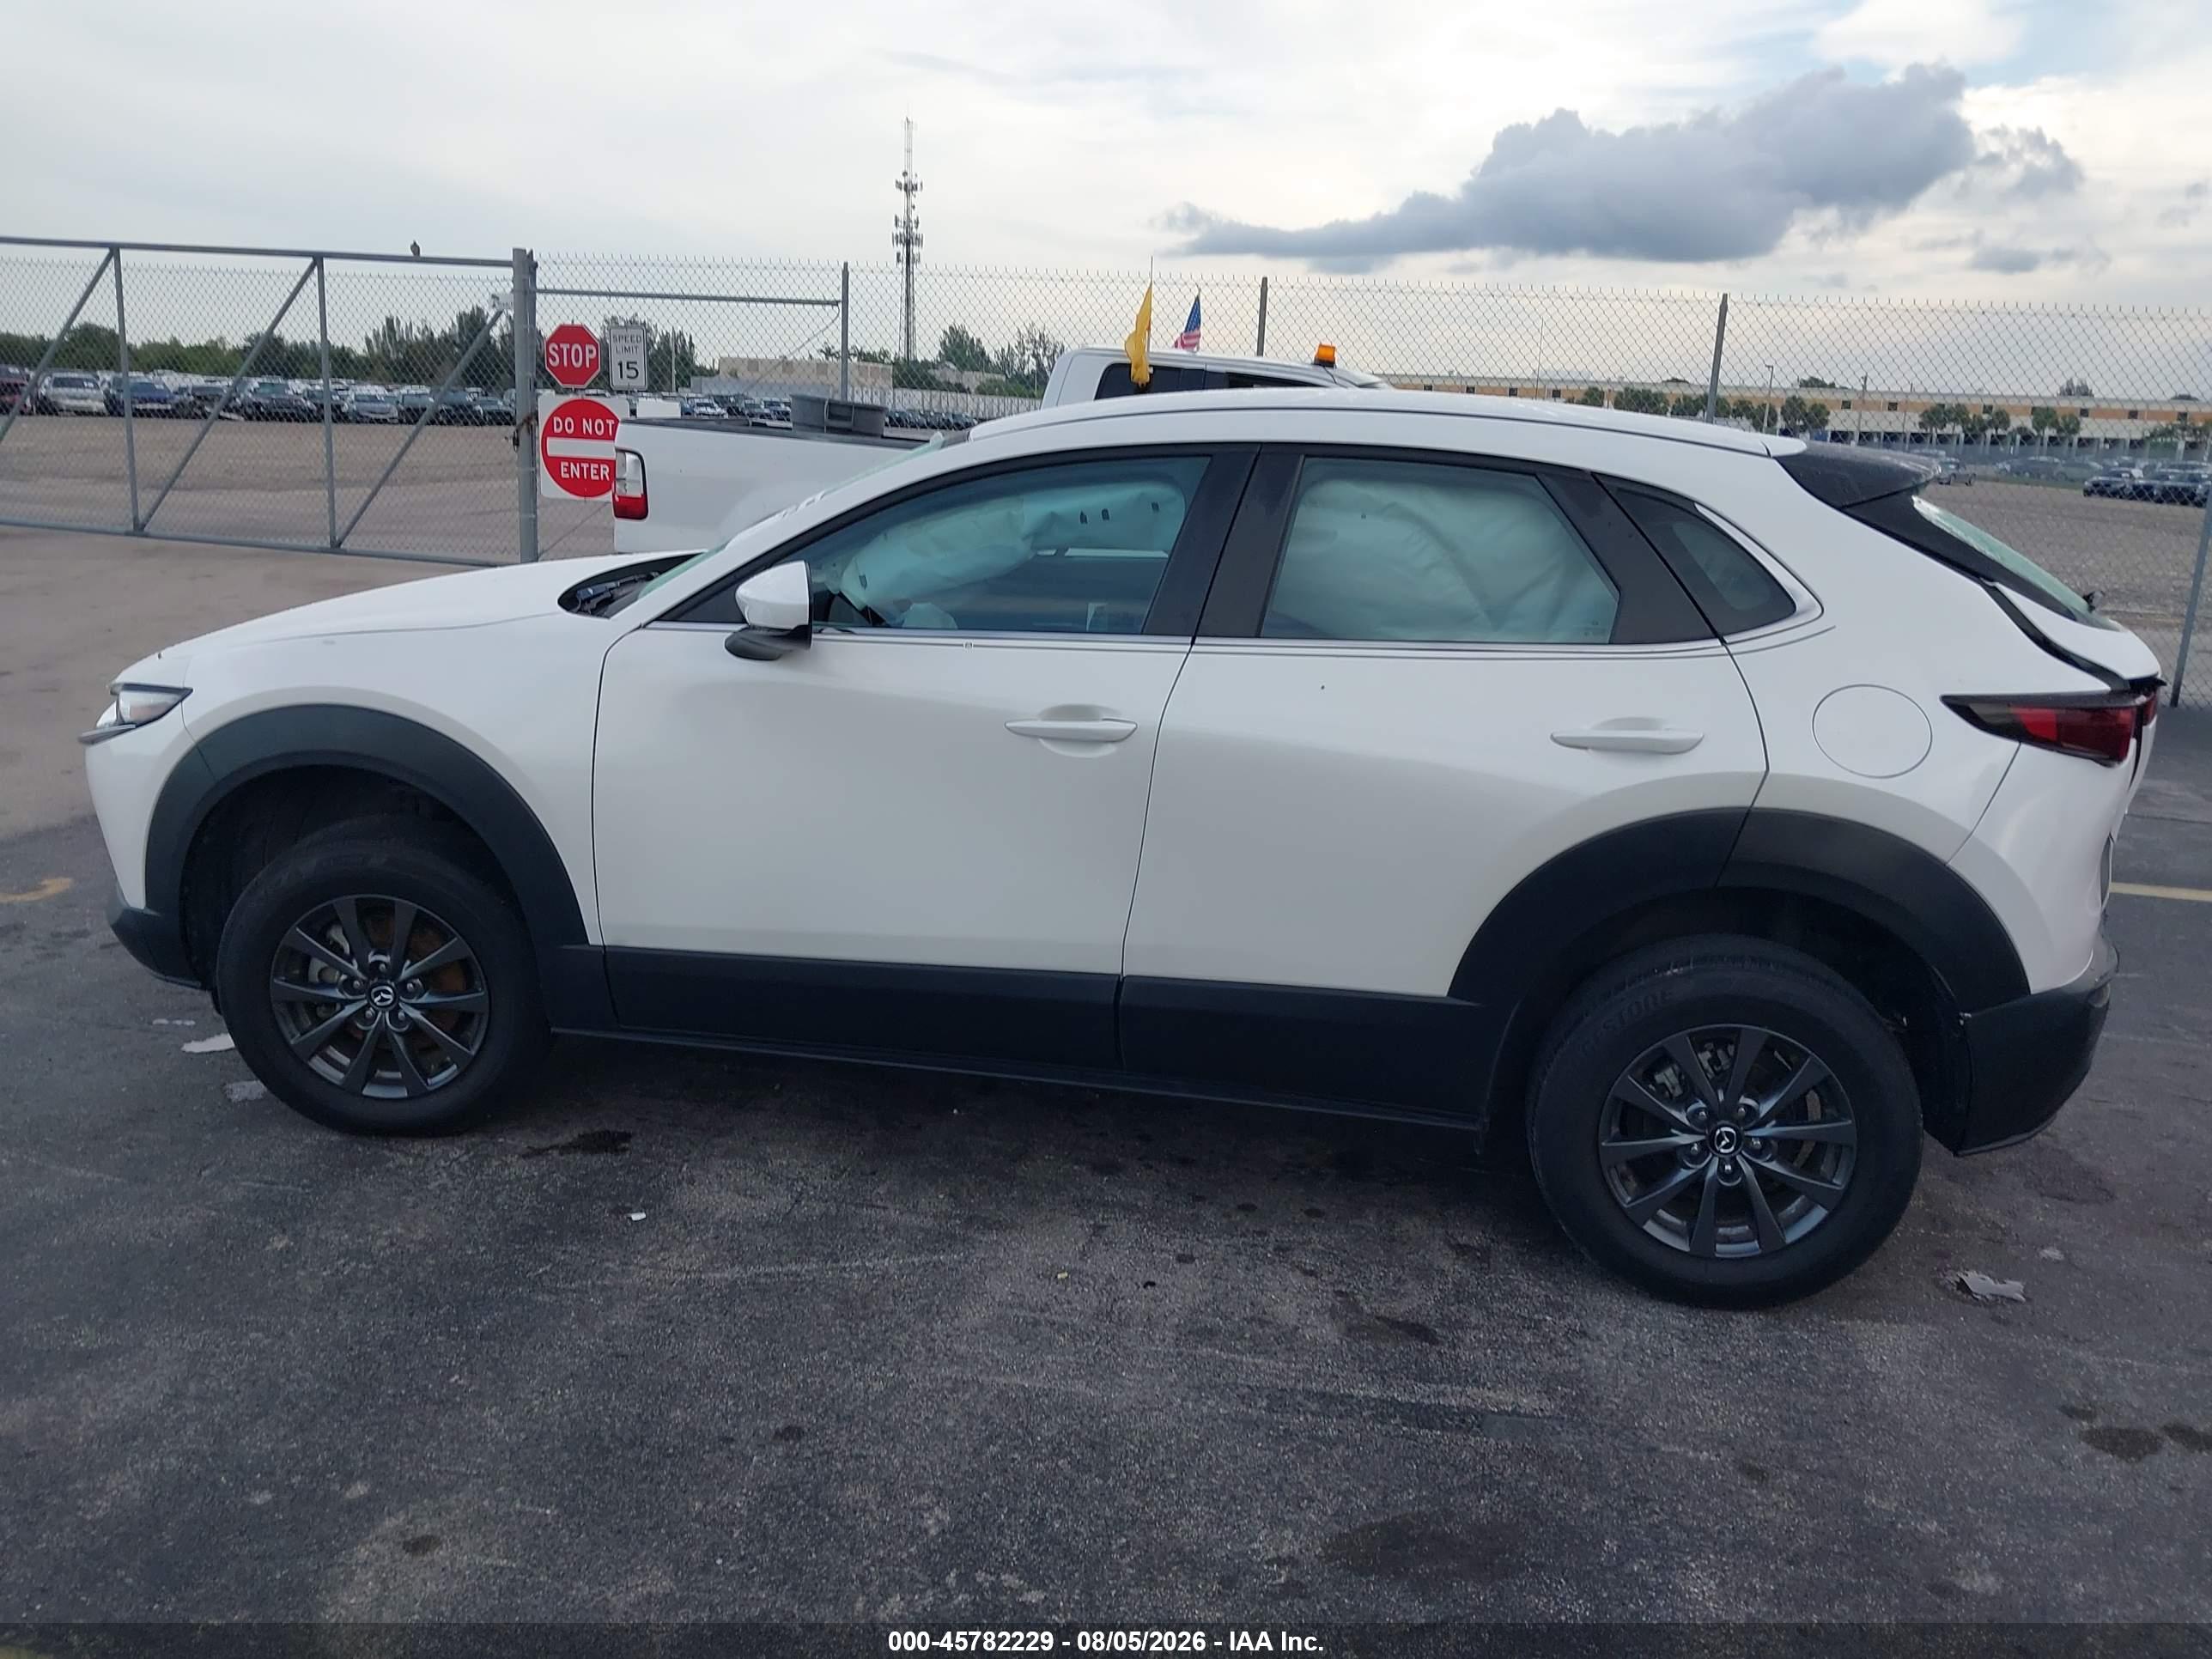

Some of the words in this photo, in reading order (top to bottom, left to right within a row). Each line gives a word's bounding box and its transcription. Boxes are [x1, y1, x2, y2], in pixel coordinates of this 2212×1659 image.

[612, 334, 642, 343] SPEED
[548, 343, 597, 368] STOP
[616, 344, 639, 354] LIMIT
[617, 361, 640, 380] 15
[553, 416, 574, 434] DO
[582, 418, 616, 437] NOT
[560, 461, 610, 481] ENTER
